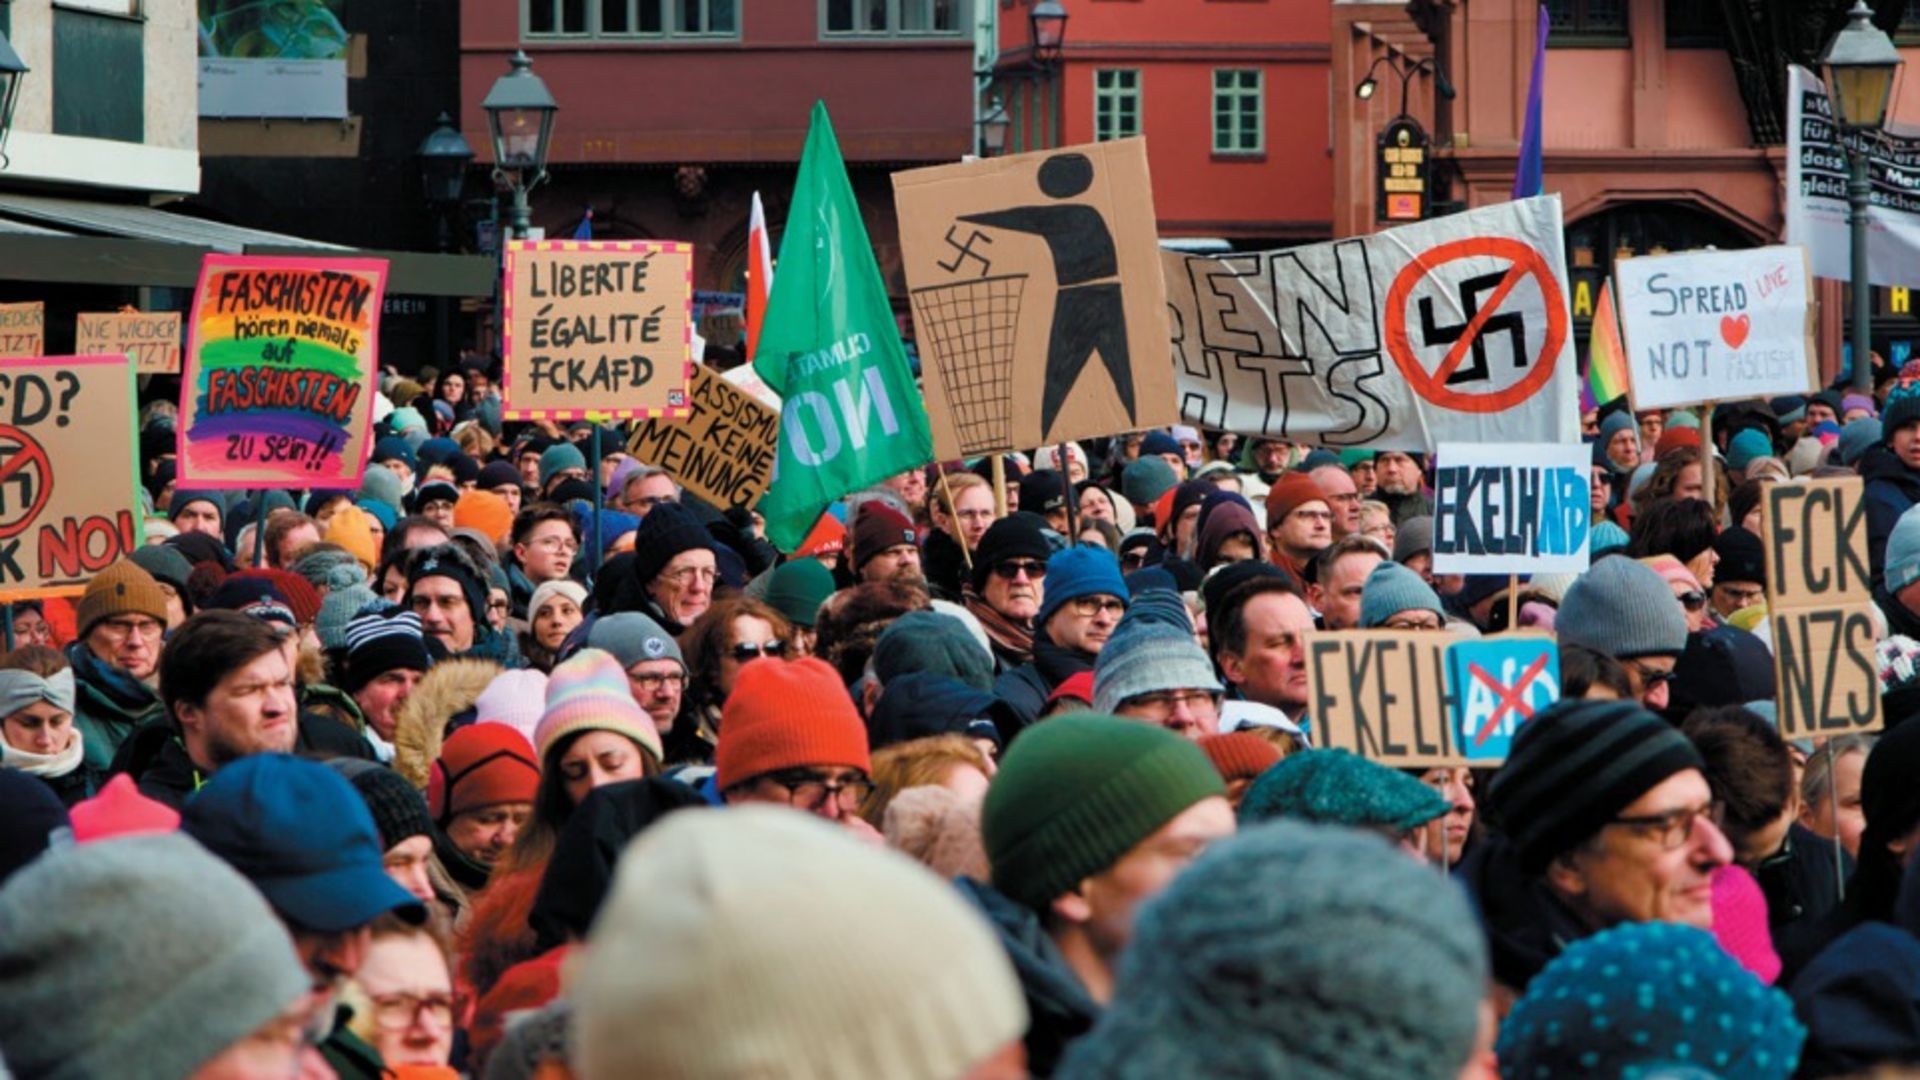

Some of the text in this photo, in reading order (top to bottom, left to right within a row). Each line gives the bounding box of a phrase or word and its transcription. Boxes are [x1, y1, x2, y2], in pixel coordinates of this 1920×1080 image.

[1802, 150, 1844, 170] dass
[217, 270, 370, 322] FASCHISTEN
[530, 250, 658, 298] LIBERTÉ
[1755, 265, 1789, 299] LOVE
[82, 320, 176, 340] NIE WIEDER
[235, 315, 359, 355] hören niemals
[530, 303, 666, 348] ÉGALITÉ
[261, 337, 296, 363] auf
[1648, 340, 1712, 380] NOT
[206, 366, 361, 421] FASCHISTEN
[529, 355, 654, 394] FCKAFD
[690, 362, 776, 452] ASSISMU
[632, 417, 762, 506] MEINUNG
[704, 417, 774, 476] KEINE
[1769, 486, 1871, 596] FCK
[1776, 610, 1877, 734] NZS
